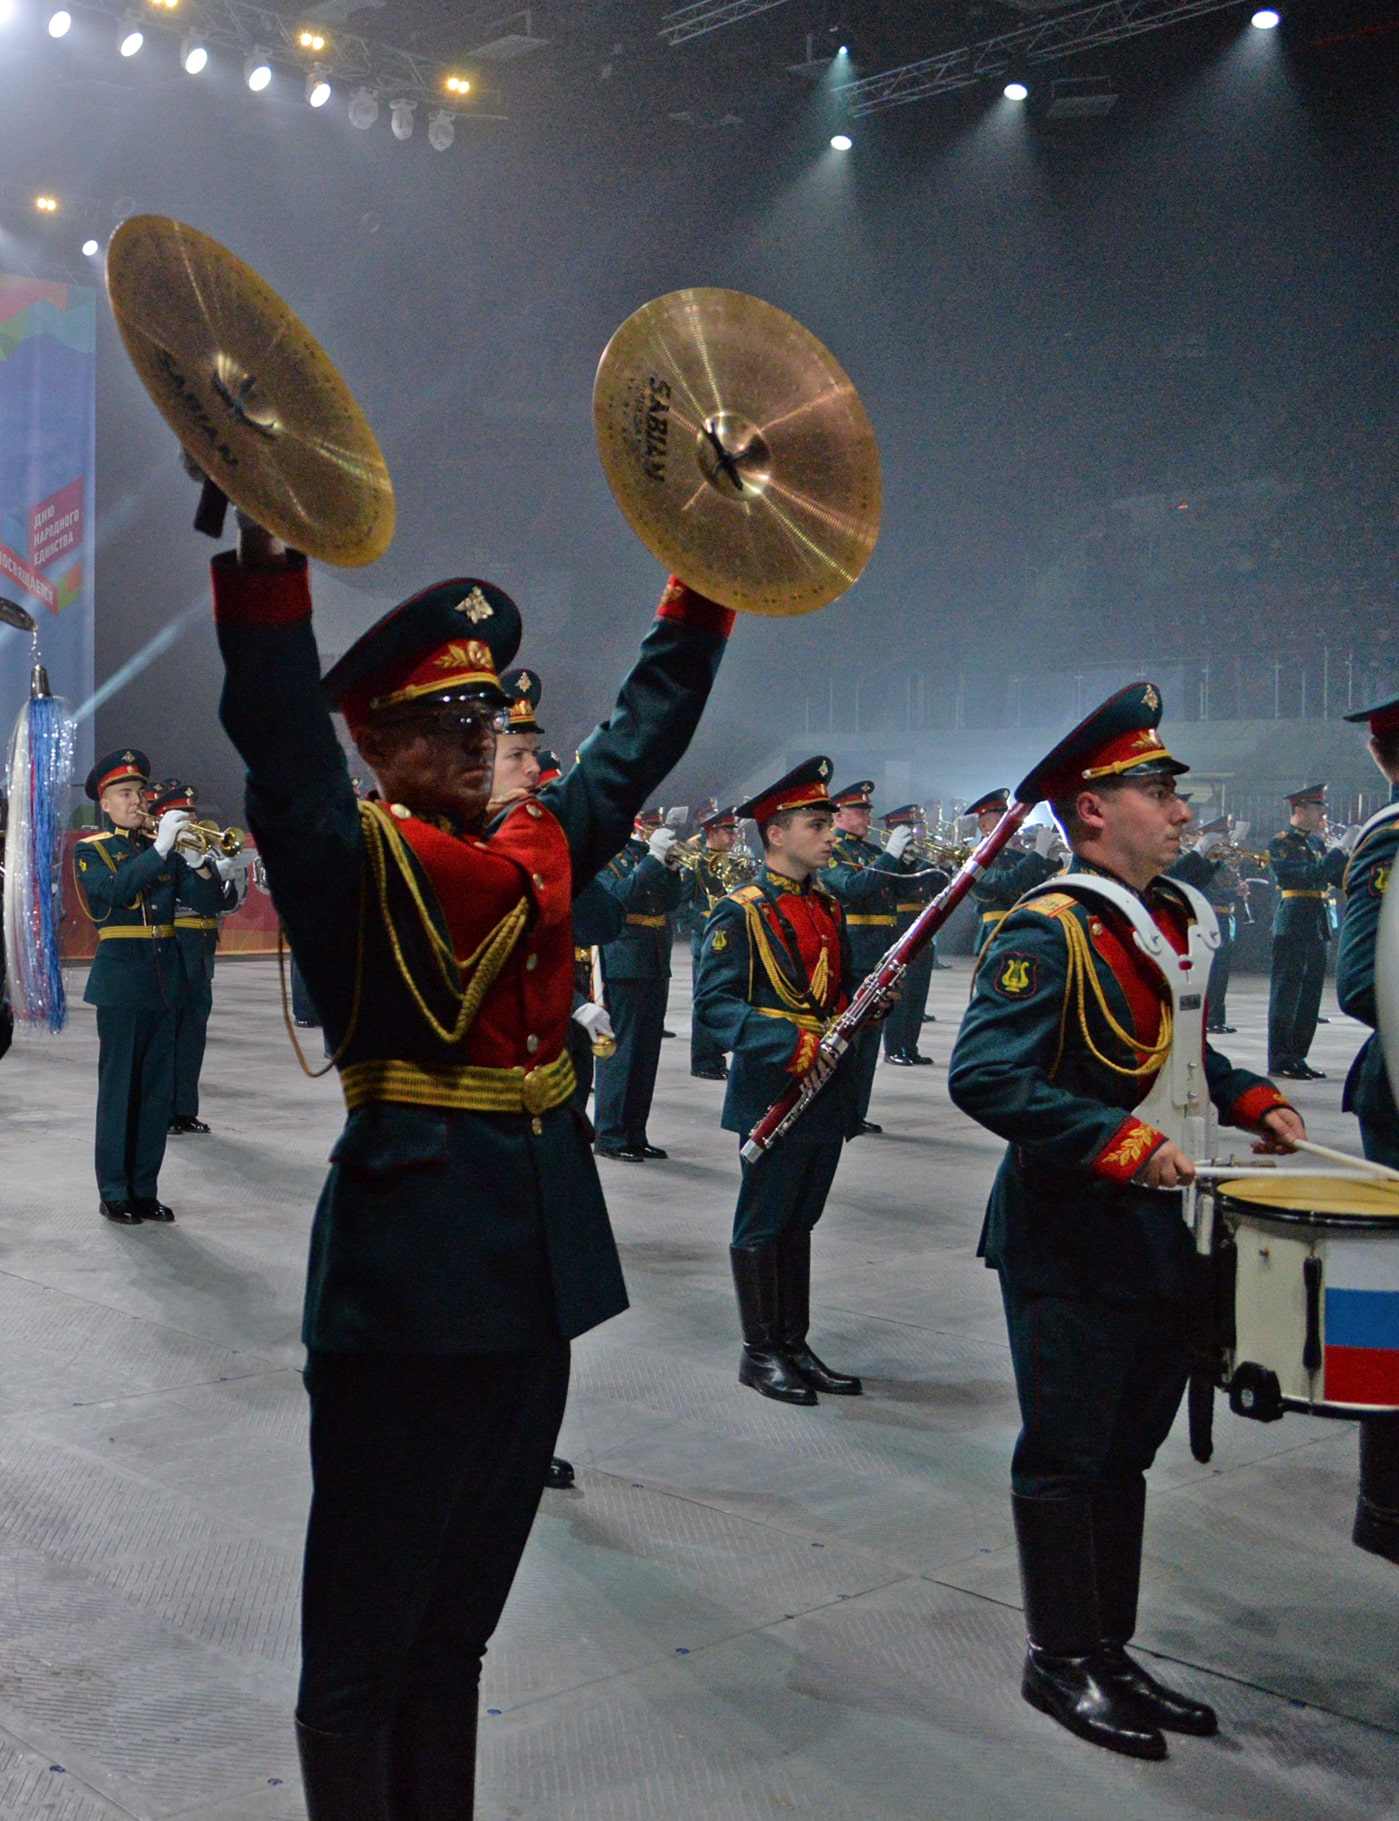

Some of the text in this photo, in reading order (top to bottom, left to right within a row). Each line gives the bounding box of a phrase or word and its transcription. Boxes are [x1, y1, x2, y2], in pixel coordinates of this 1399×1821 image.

[645, 375, 672, 483] SABIAN
[33, 504, 55, 530] ДНЮ
[33, 508, 80, 546] НАРОДНОГО
[33, 531, 74, 566] ЕДИНСТВА
